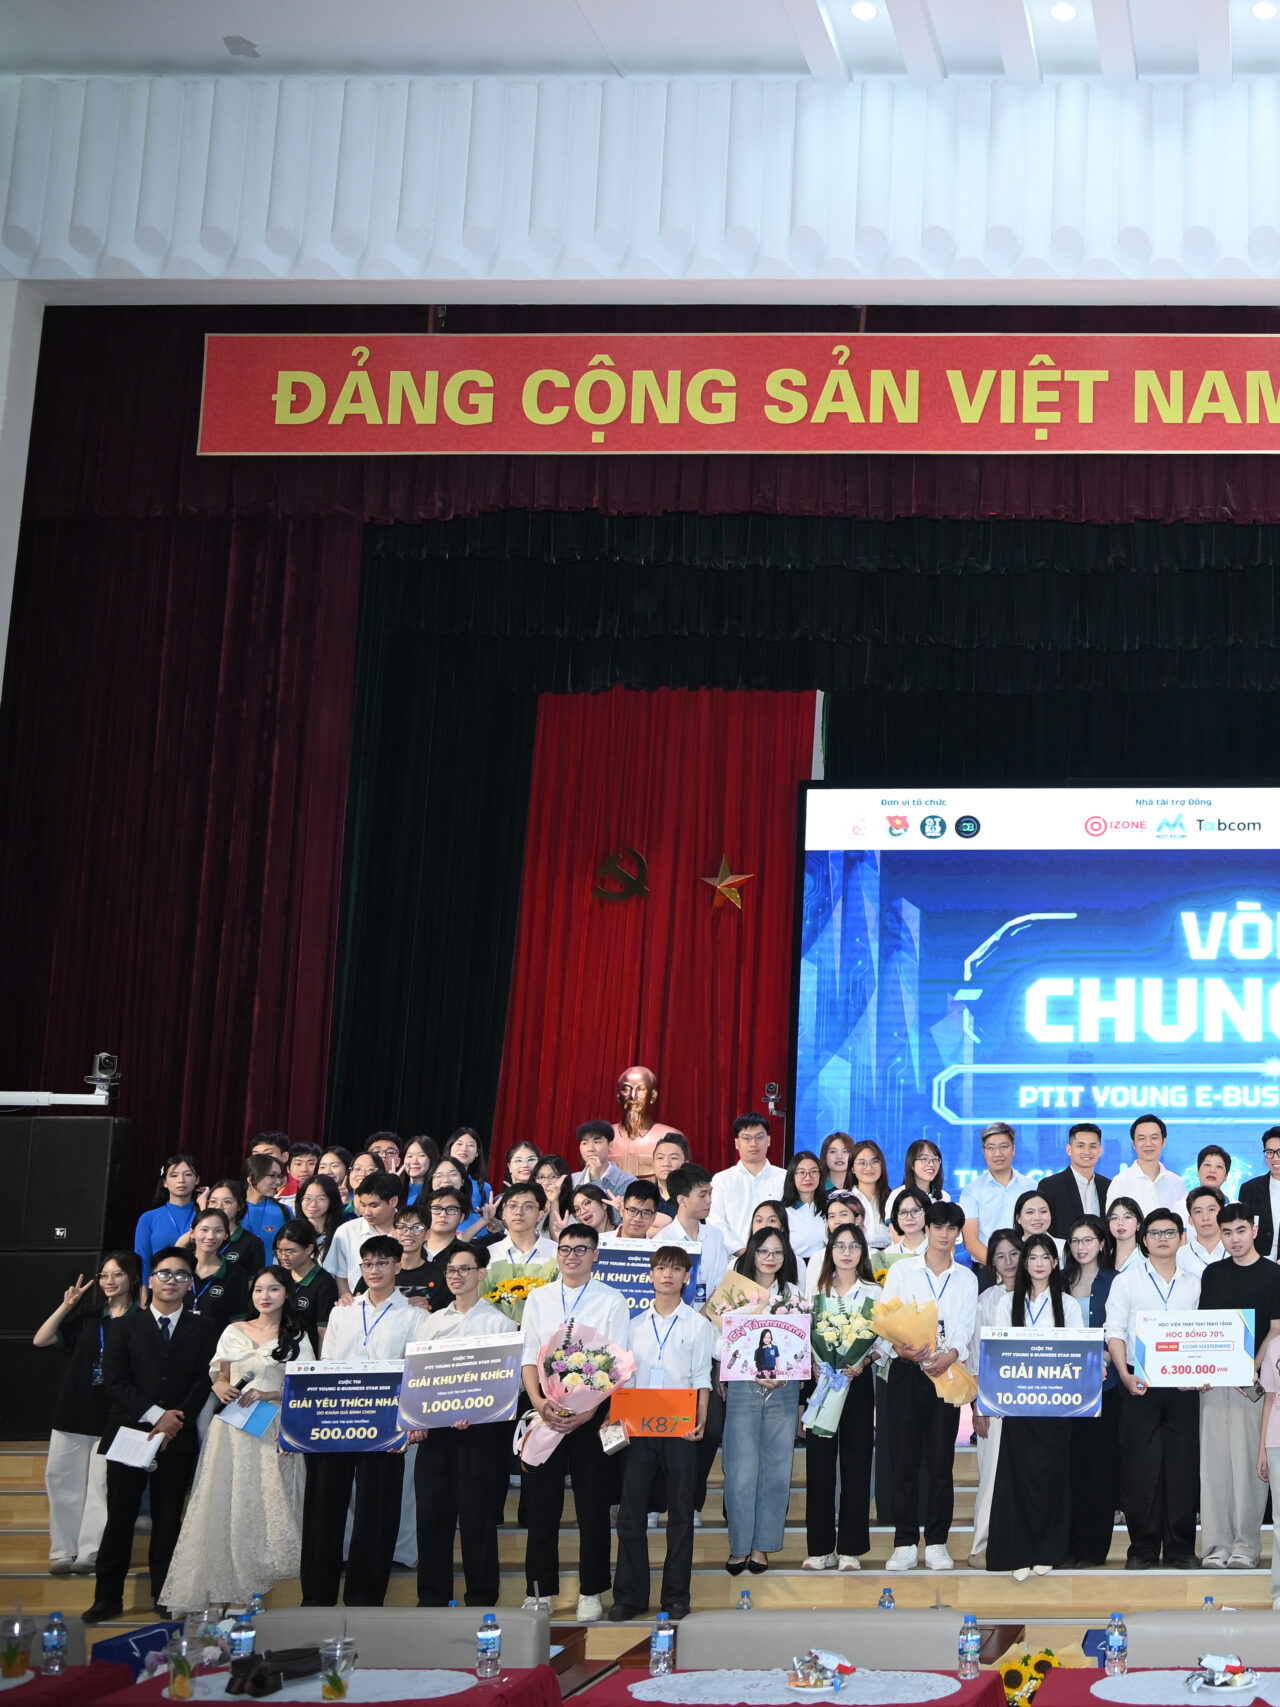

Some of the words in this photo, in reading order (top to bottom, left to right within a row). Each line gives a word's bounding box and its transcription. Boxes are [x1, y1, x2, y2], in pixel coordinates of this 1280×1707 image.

[272, 345, 494, 425] ĐẢNG
[521, 354, 736, 443] CỘNG
[763, 345, 919, 425] SẢN
[946, 354, 1107, 440] VIỆT
[1110, 820, 1147, 829] IZONE
[1196, 819, 1261, 831] Tabcom
[1019, 1086, 1084, 1108] PTIT
[1092, 1085, 1187, 1108] YOUNG
[727, 1326, 747, 1342] Chị
[1185, 1329, 1207, 1338] BỔNG
[999, 1362, 1033, 1379] GIẢI
[1037, 1362, 1082, 1379] NHẤT
[1160, 1365, 1216, 1375] 6.300.000
[408, 1376, 430, 1388] GIẢI
[433, 1371, 478, 1386] KHUYẾN
[481, 1369, 514, 1381] KHÍCH
[288, 1397, 312, 1409] GIẢI
[315, 1396, 337, 1408] YÊU
[341, 1396, 372, 1408] THÍCH
[375, 1395, 400, 1407] NHẤ
[421, 1395, 494, 1414] 1.000.000
[996, 1392, 1082, 1405] 10.000.000
[641, 1416, 680, 1433] K87
[310, 1427, 378, 1440] 500.000
